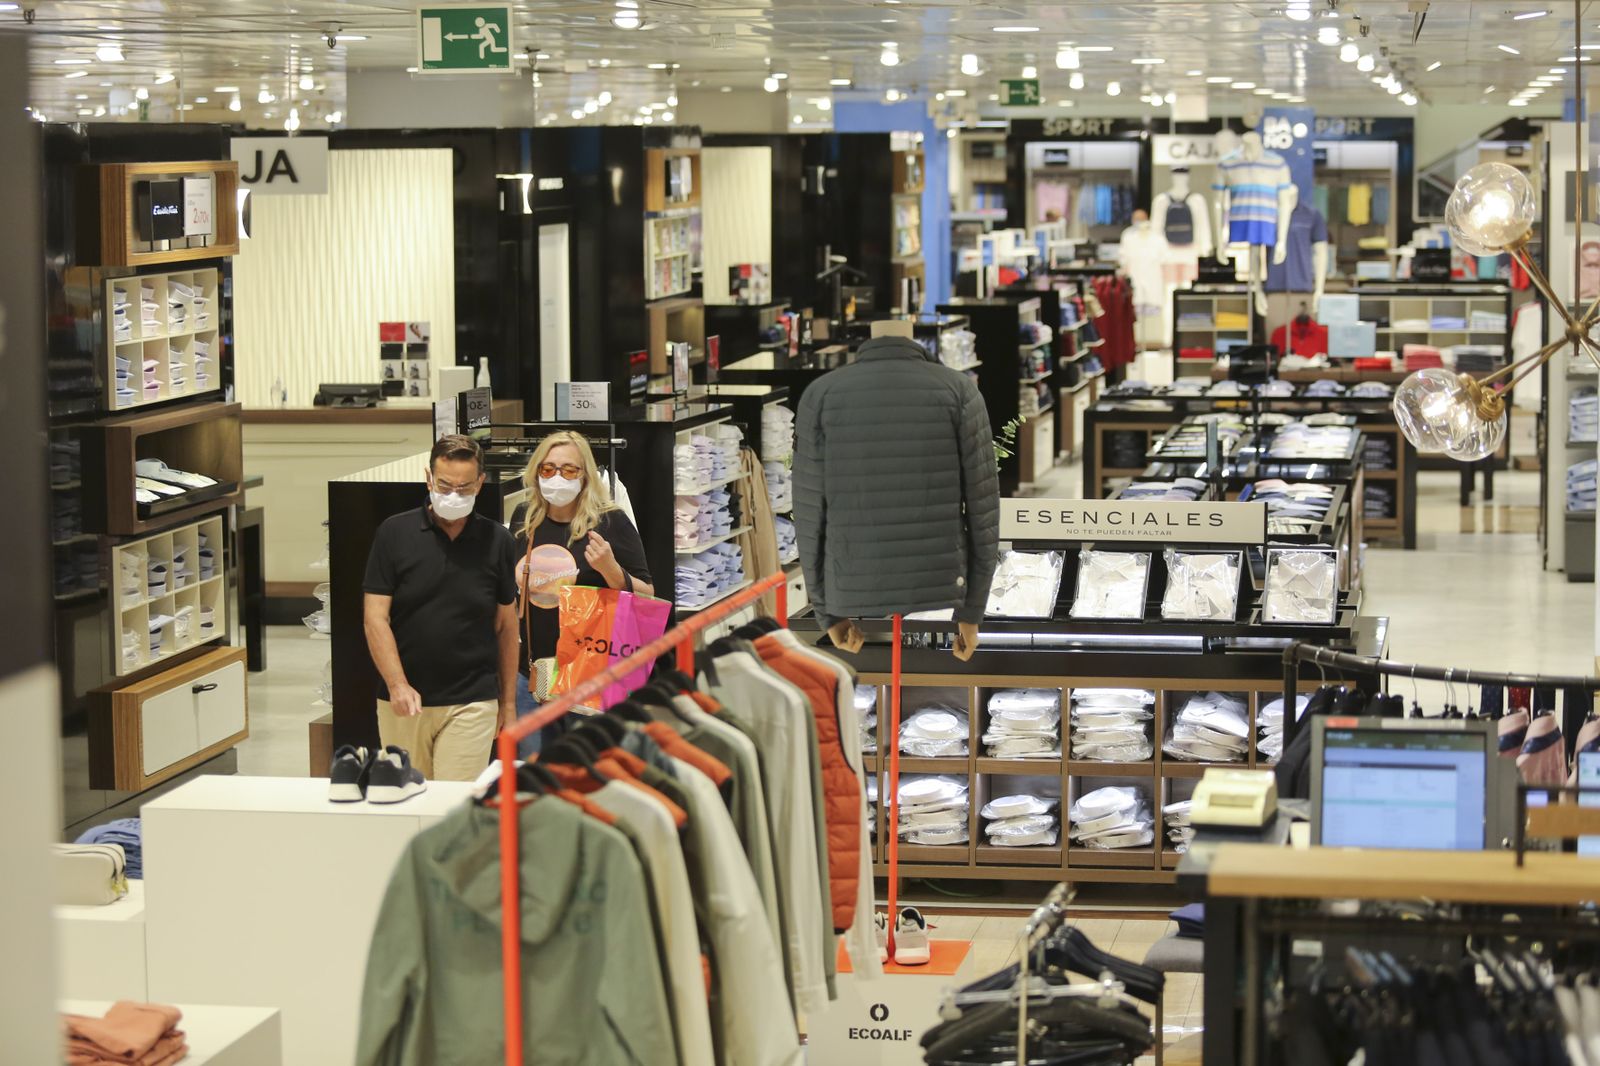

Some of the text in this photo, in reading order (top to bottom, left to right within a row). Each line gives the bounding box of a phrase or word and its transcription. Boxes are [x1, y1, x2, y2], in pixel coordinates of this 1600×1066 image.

[1043, 118, 1114, 136] SPORT
[1169, 141, 1219, 159] CAJ
[241, 149, 299, 184] JA
[1016, 509, 1224, 527] ESENCIALES
[849, 1027, 913, 1041] ECOALF
